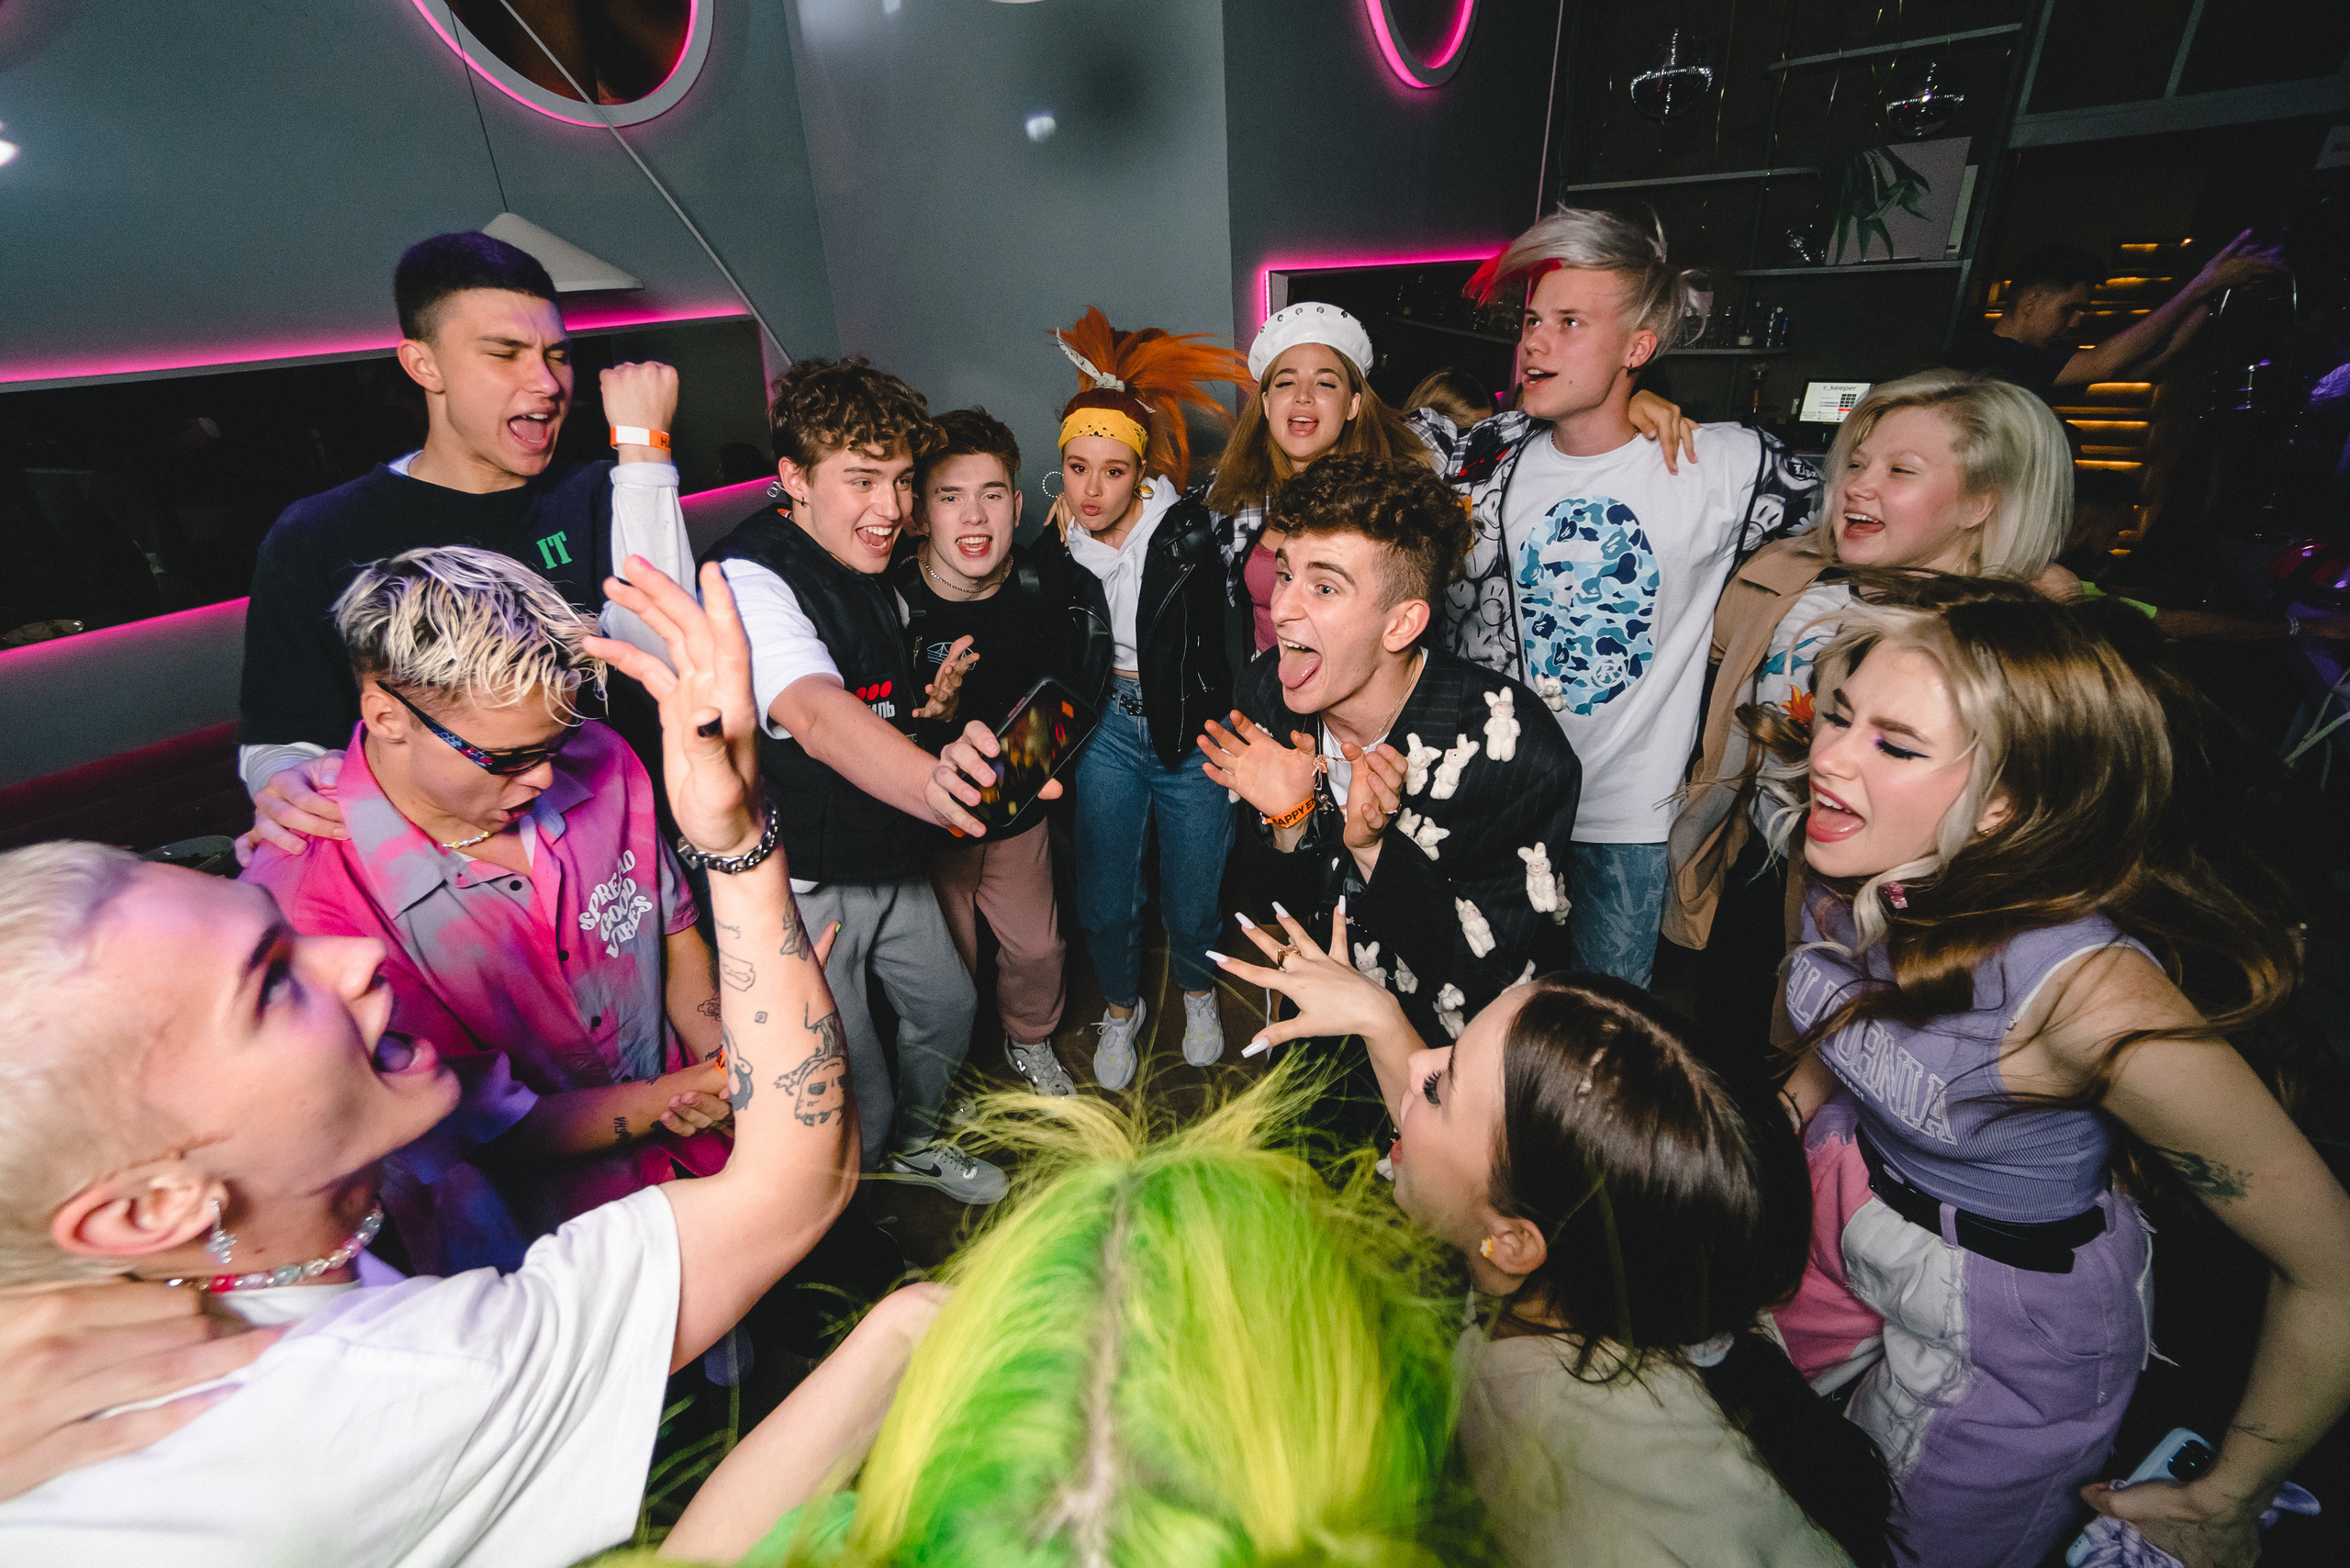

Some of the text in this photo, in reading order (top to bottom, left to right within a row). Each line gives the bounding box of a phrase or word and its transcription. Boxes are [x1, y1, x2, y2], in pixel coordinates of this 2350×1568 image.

[536, 531, 572, 569] IT
[578, 850, 635, 930] SPREAD
[599, 878, 637, 942] GOOD
[606, 895, 653, 958] VIBES
